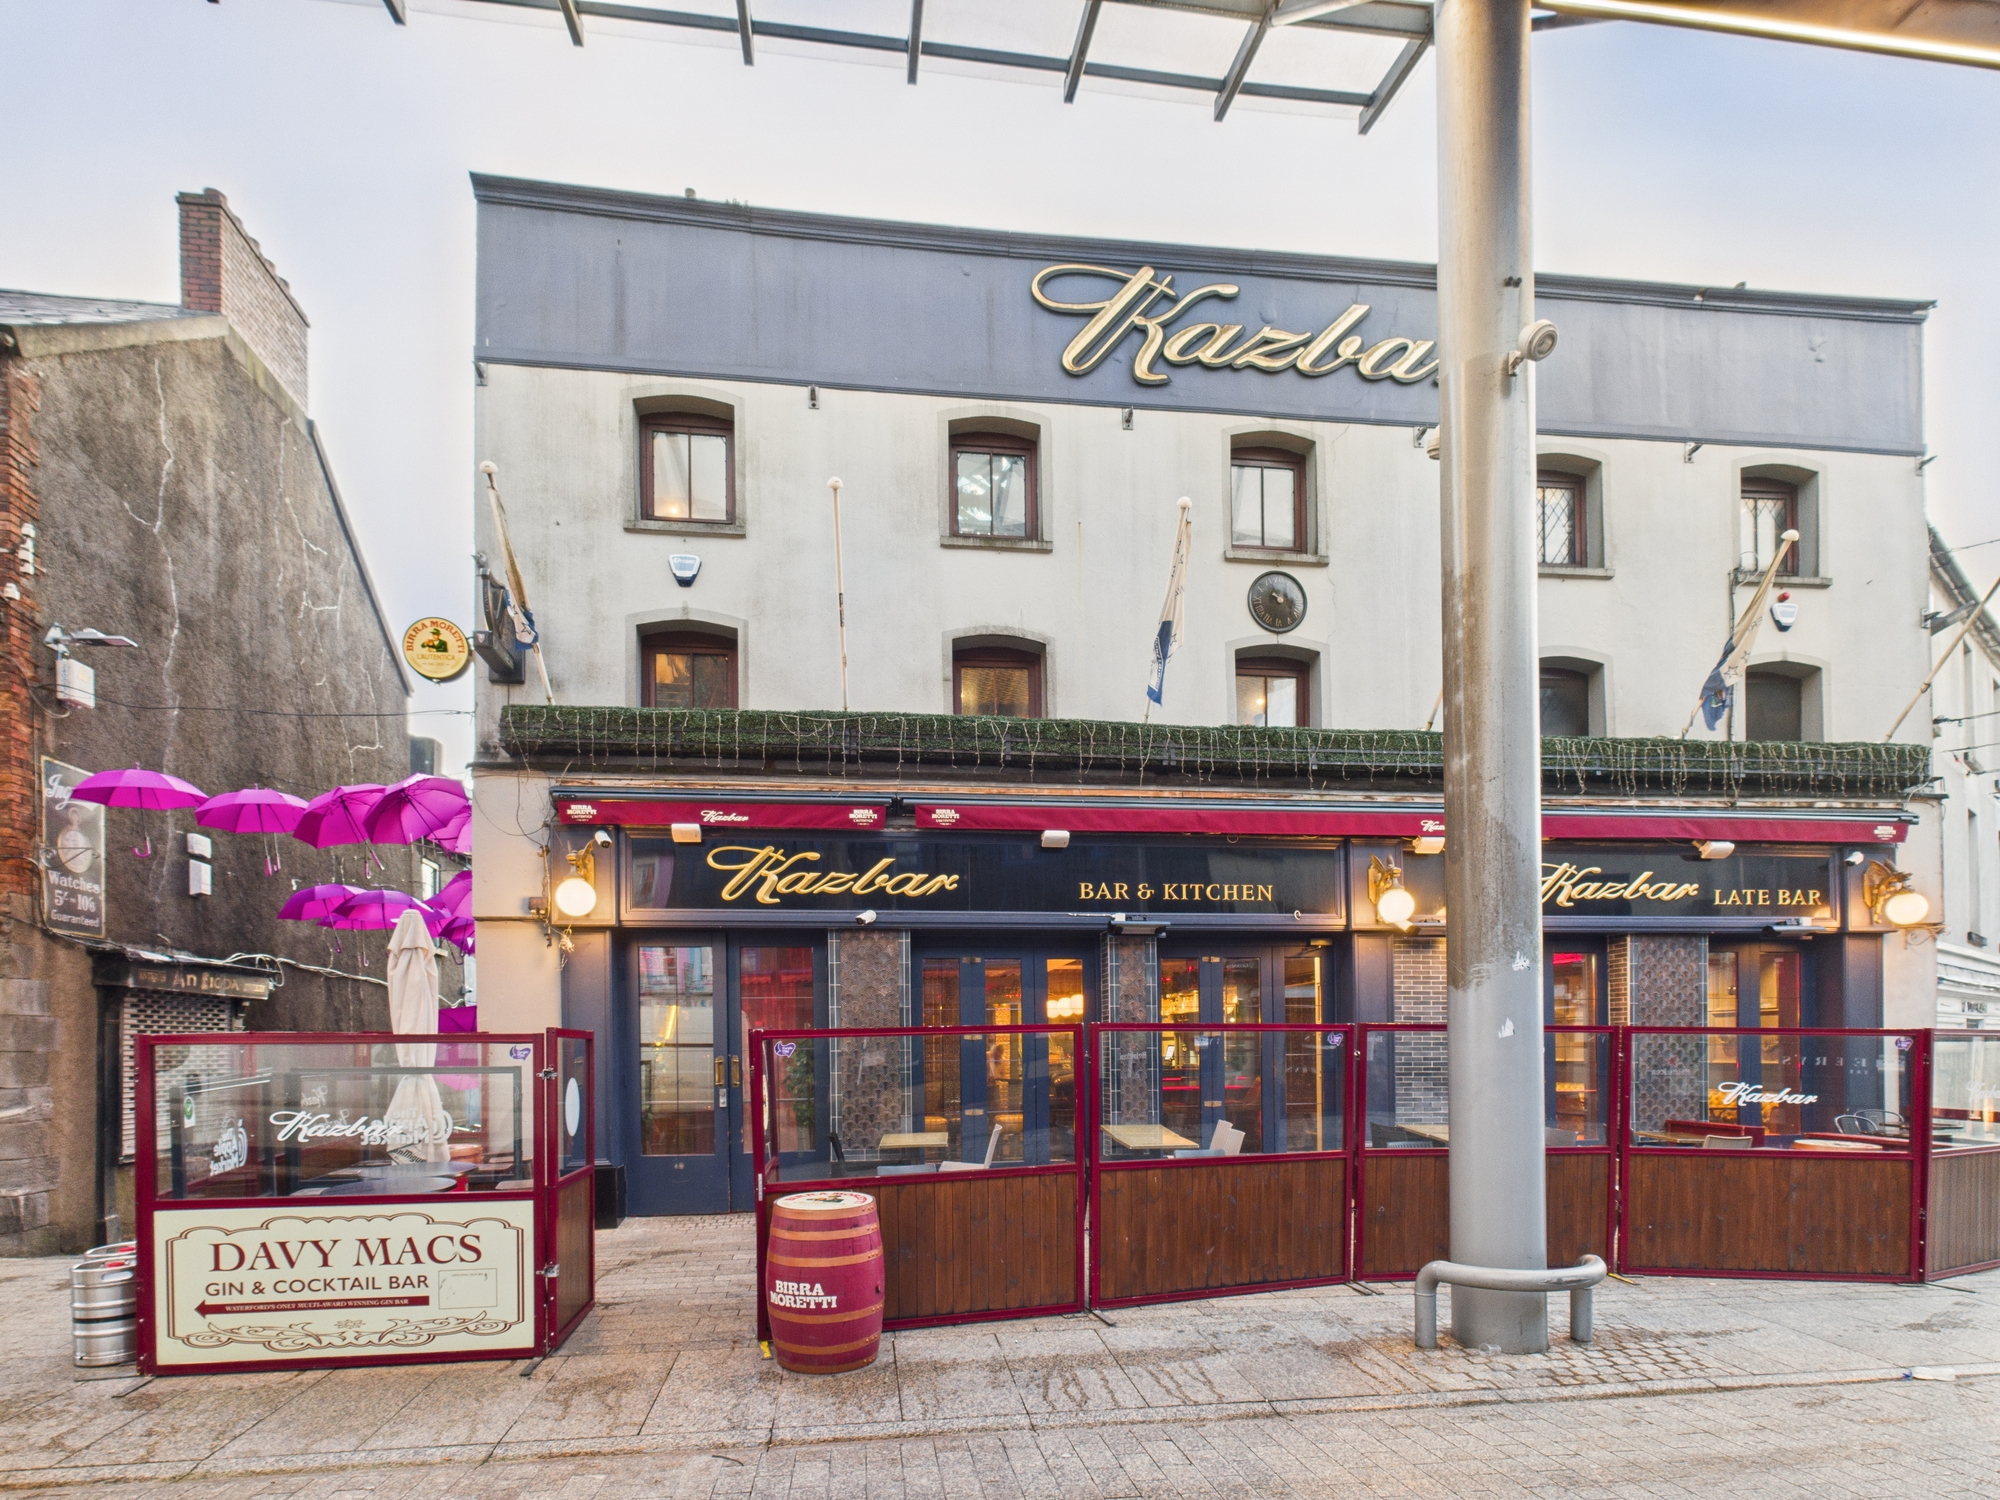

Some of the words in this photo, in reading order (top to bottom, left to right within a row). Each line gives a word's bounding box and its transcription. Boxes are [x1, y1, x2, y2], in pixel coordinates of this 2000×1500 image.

[1031, 263, 1439, 386] Kazba
[406, 622, 429, 651] BIRRA
[430, 620, 466, 654] MORETTI
[700, 810, 749, 823] Kazbar
[1420, 820, 1445, 832] Kaz
[48, 869, 101, 895] Watches
[706, 845, 960, 905] Kazbar
[1541, 862, 1699, 908] Kazbar
[1079, 882, 1130, 900] BAR
[1137, 882, 1155, 900] &
[1162, 883, 1274, 901] KITCHEN
[1713, 889, 1770, 906] LATE
[1777, 889, 1823, 906] BAR
[51, 909, 100, 928] Guaranteed
[1717, 1081, 1818, 1107] Kazbar
[269, 1111, 403, 1142] Kazbar
[208, 1238, 342, 1273] DAVY
[352, 1234, 482, 1267] MACS
[205, 1282, 244, 1296] GIN
[251, 1280, 266, 1295] &
[272, 1276, 382, 1294] COCKTAIL
[388, 1274, 429, 1289] BAR
[775, 1280, 825, 1296] BIRRA
[297, 1300, 347, 1309] MULTI-AWARD
[769, 1290, 838, 1309] MORETTI
